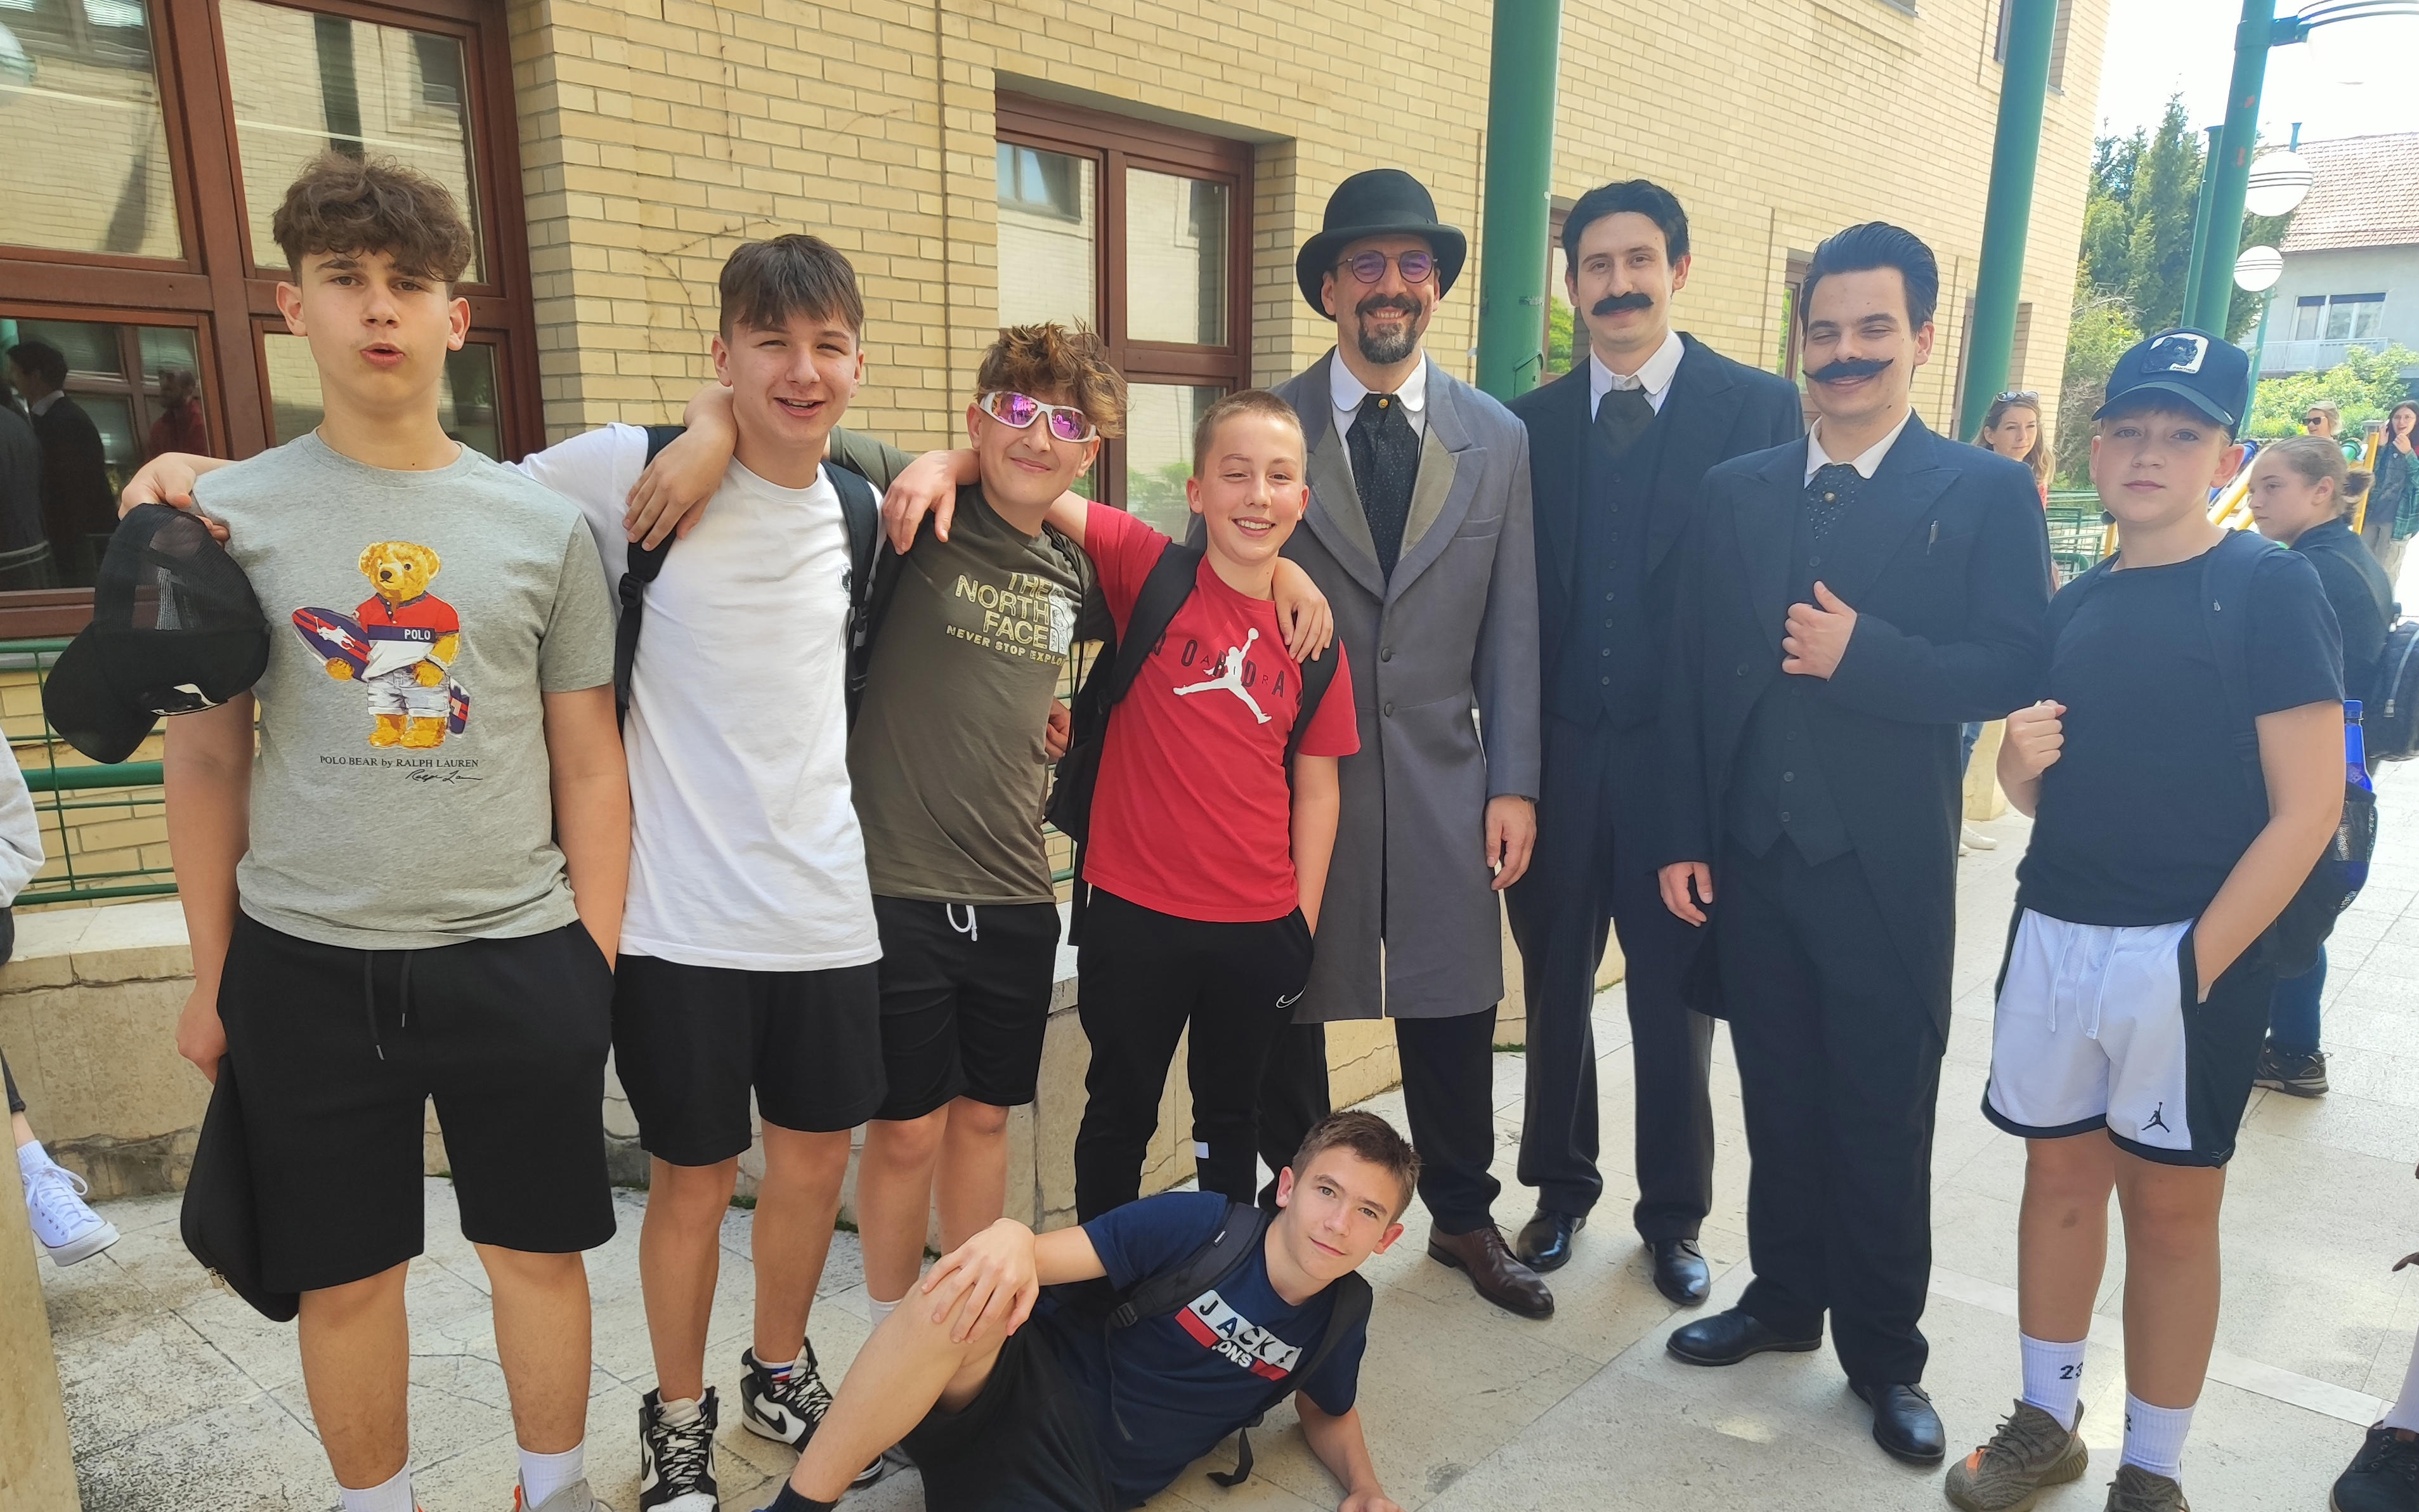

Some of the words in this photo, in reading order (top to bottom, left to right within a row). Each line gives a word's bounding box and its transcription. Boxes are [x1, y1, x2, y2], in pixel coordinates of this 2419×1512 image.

[955, 574, 1050, 625] NORTH
[1008, 572, 1050, 602] THE
[404, 629, 431, 641] POLO
[946, 625, 991, 648] NEVER
[994, 641, 1026, 656] STOP
[1029, 649, 1063, 666] EXPLO
[982, 609, 1049, 650] FACE
[1153, 632, 1303, 708] ORDA
[320, 755, 346, 765] POLO
[349, 757, 378, 766] BEAR
[381, 759, 393, 768] by
[396, 759, 433, 767] RALPH
[436, 759, 479, 767] LAUREN
[1199, 1300, 1275, 1357] JACK
[2059, 1361, 2083, 1379] 23
